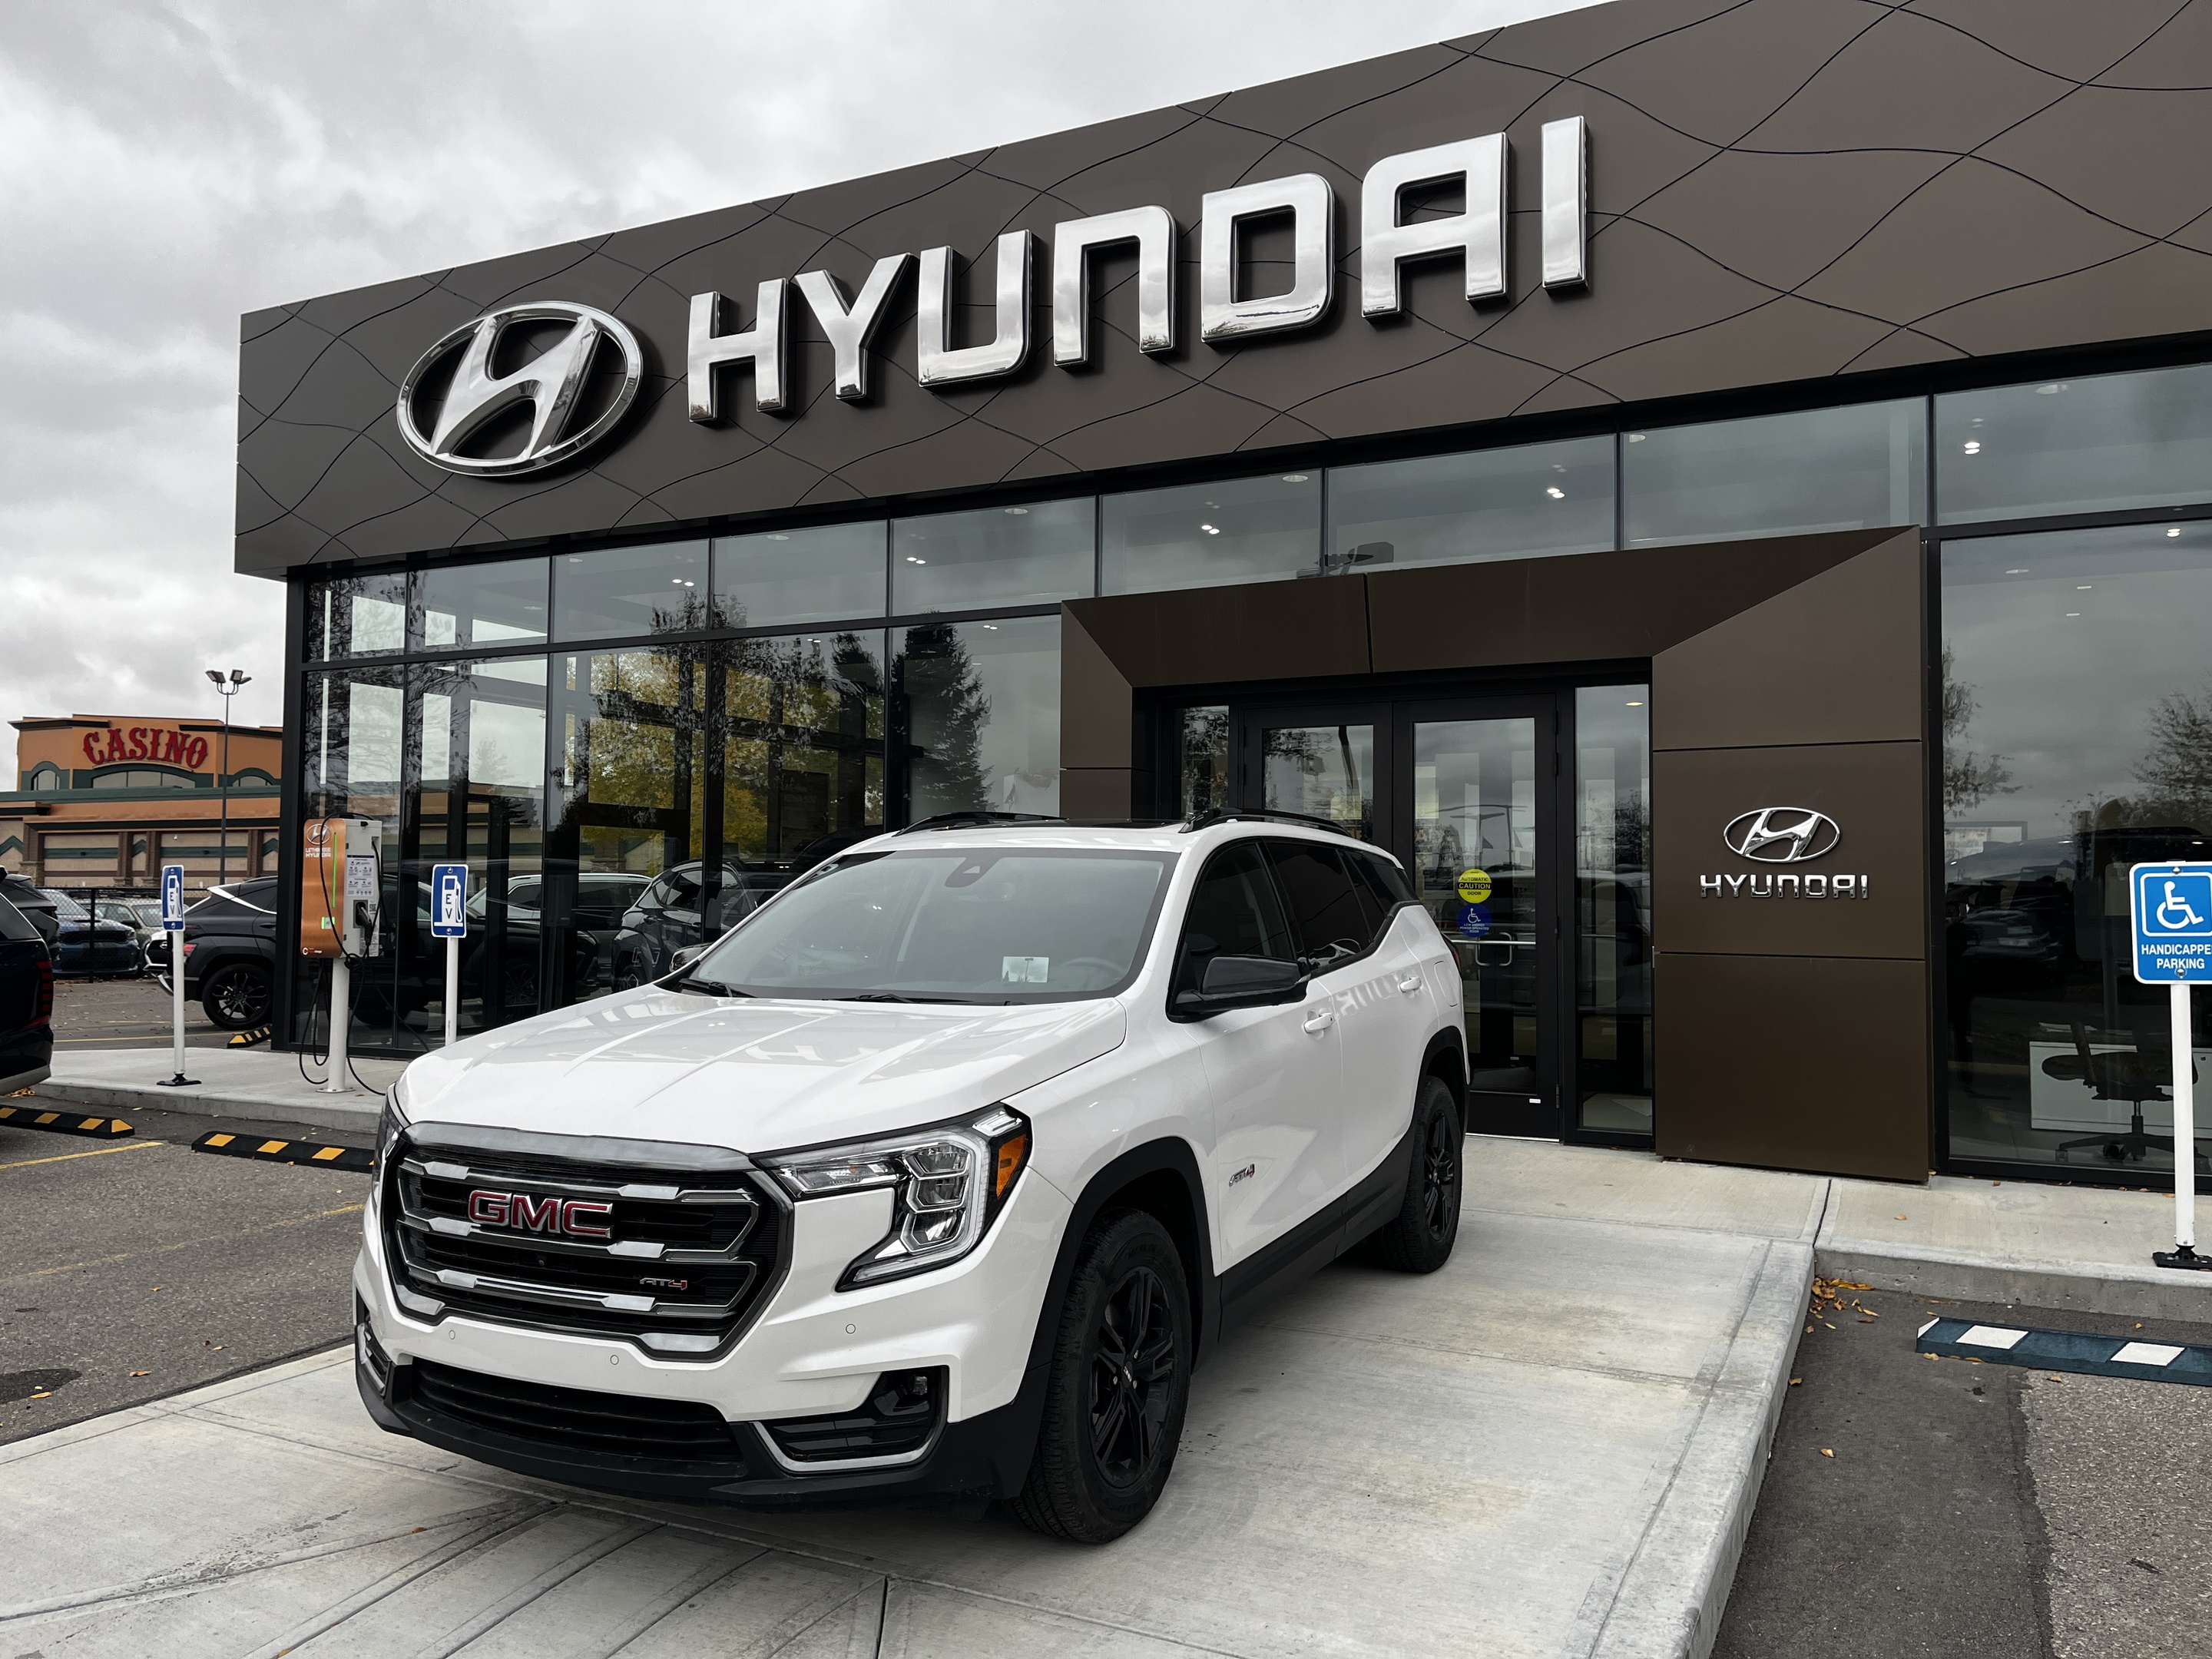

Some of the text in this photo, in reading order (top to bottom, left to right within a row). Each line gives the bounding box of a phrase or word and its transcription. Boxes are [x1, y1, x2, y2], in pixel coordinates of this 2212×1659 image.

[687, 115, 1588, 422] HYUNDAI
[83, 727, 208, 769] CASINO
[1700, 874, 1869, 899] HYUNDAI
[2141, 944, 2212, 955] HANDICAPPE
[2157, 958, 2205, 969] PARKING
[469, 1190, 614, 1239] GMC
[640, 1277, 687, 1290] AT4
